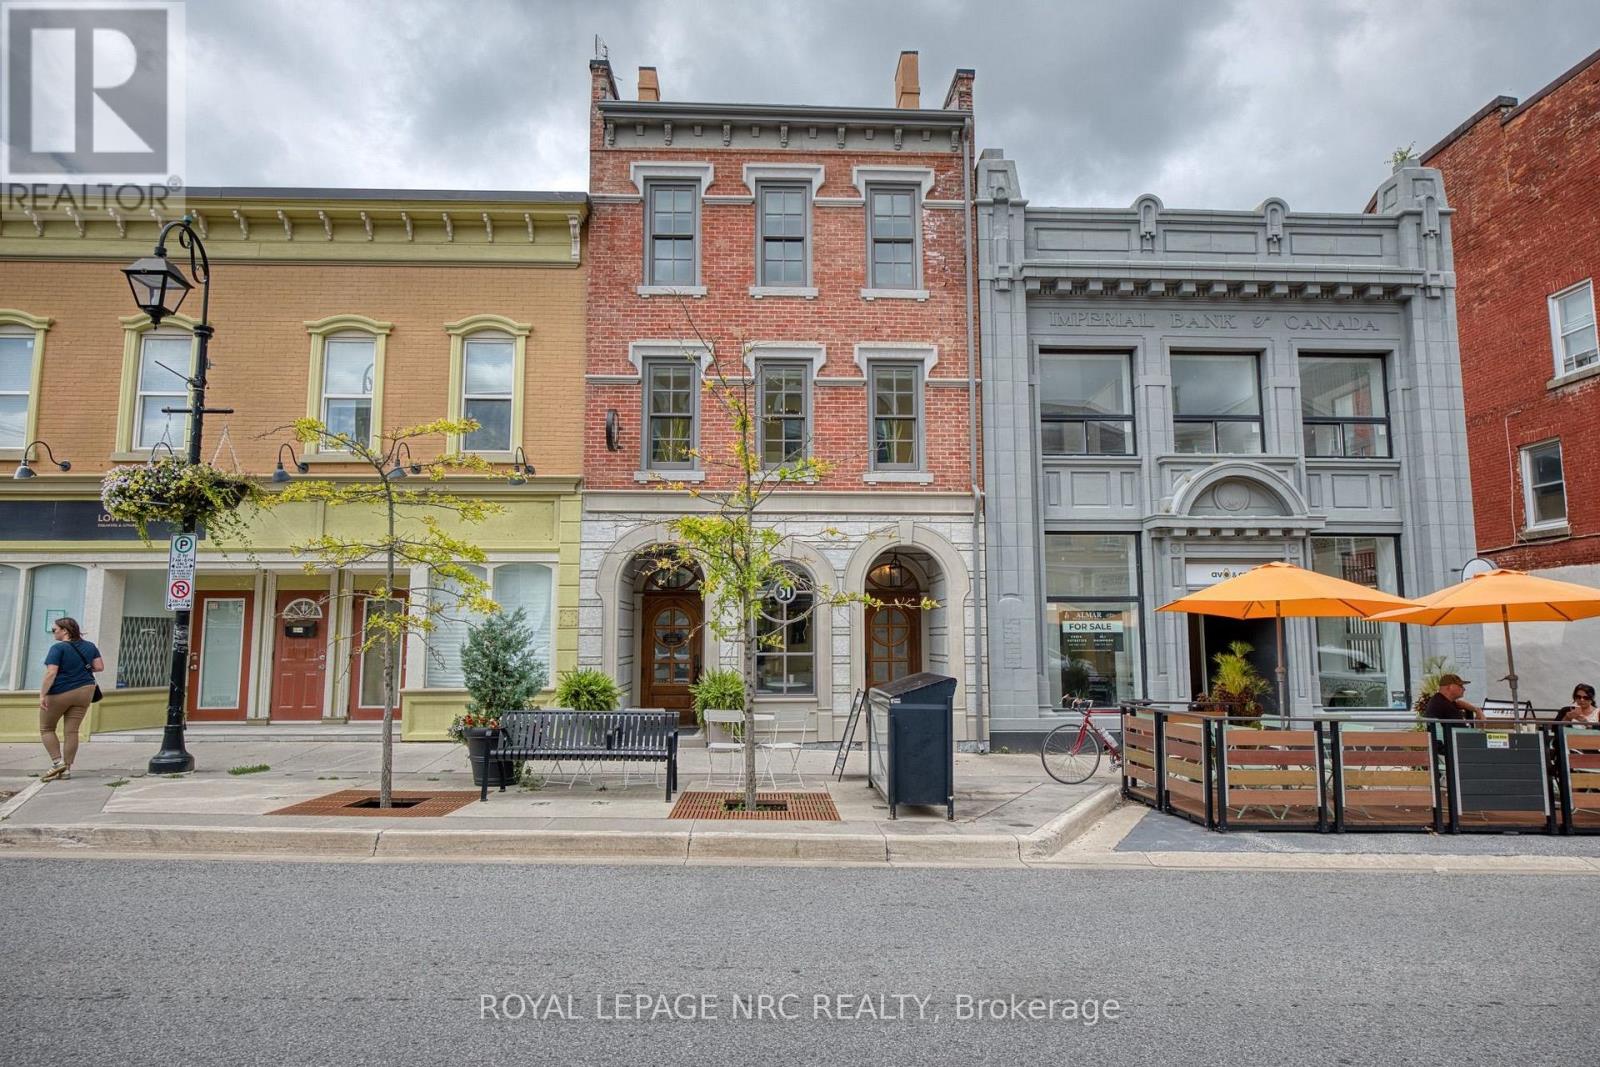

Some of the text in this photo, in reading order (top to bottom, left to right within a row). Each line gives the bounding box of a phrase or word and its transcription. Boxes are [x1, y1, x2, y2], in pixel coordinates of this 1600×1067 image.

[1049, 311, 1155, 328] IMPERIAL
[1170, 313, 1238, 329] BANK
[1285, 315, 1380, 331] CANADA
[180, 540, 188, 549] P
[779, 586, 791, 598] 51
